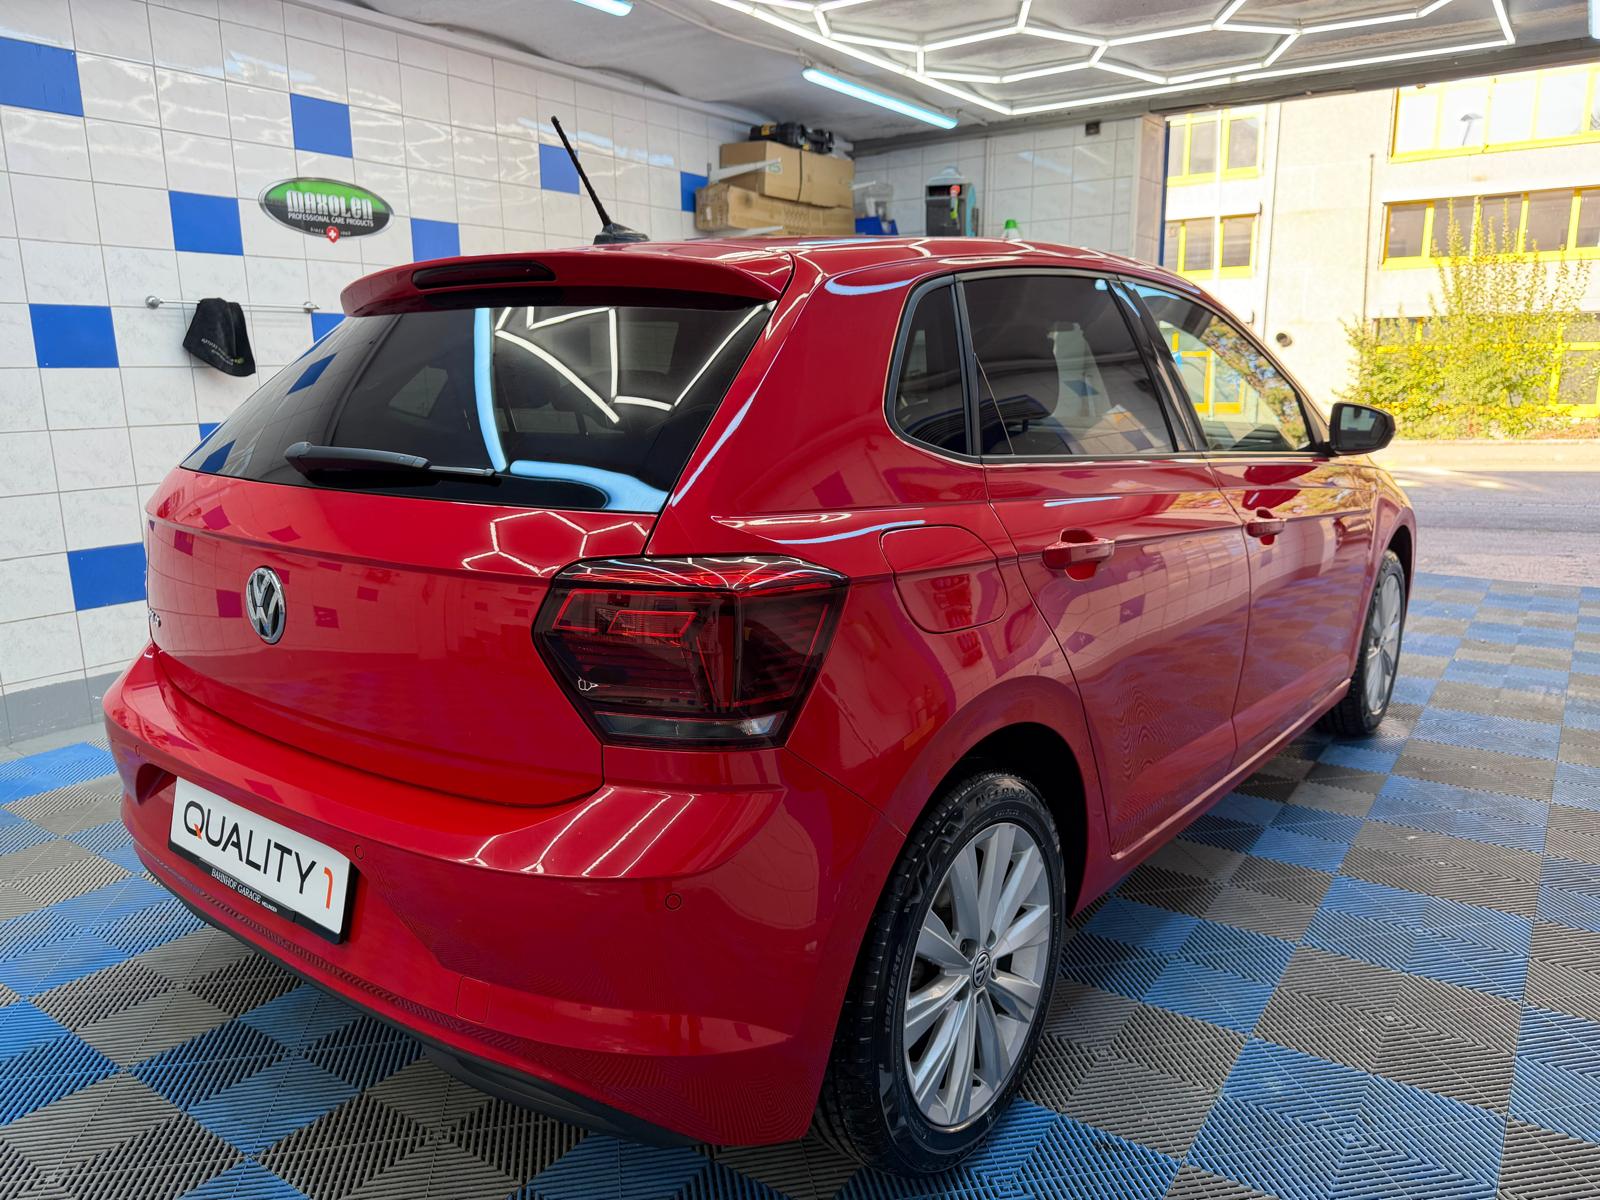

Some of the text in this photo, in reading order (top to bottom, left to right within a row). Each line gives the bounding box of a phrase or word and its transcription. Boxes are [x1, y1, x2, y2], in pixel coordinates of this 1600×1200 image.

[288, 212, 330, 223] PROFESSIONAL
[346, 218, 374, 227] PRODUCTS
[211, 868, 238, 890] BAHNHOF
[237, 884, 262, 904] GARAGE
